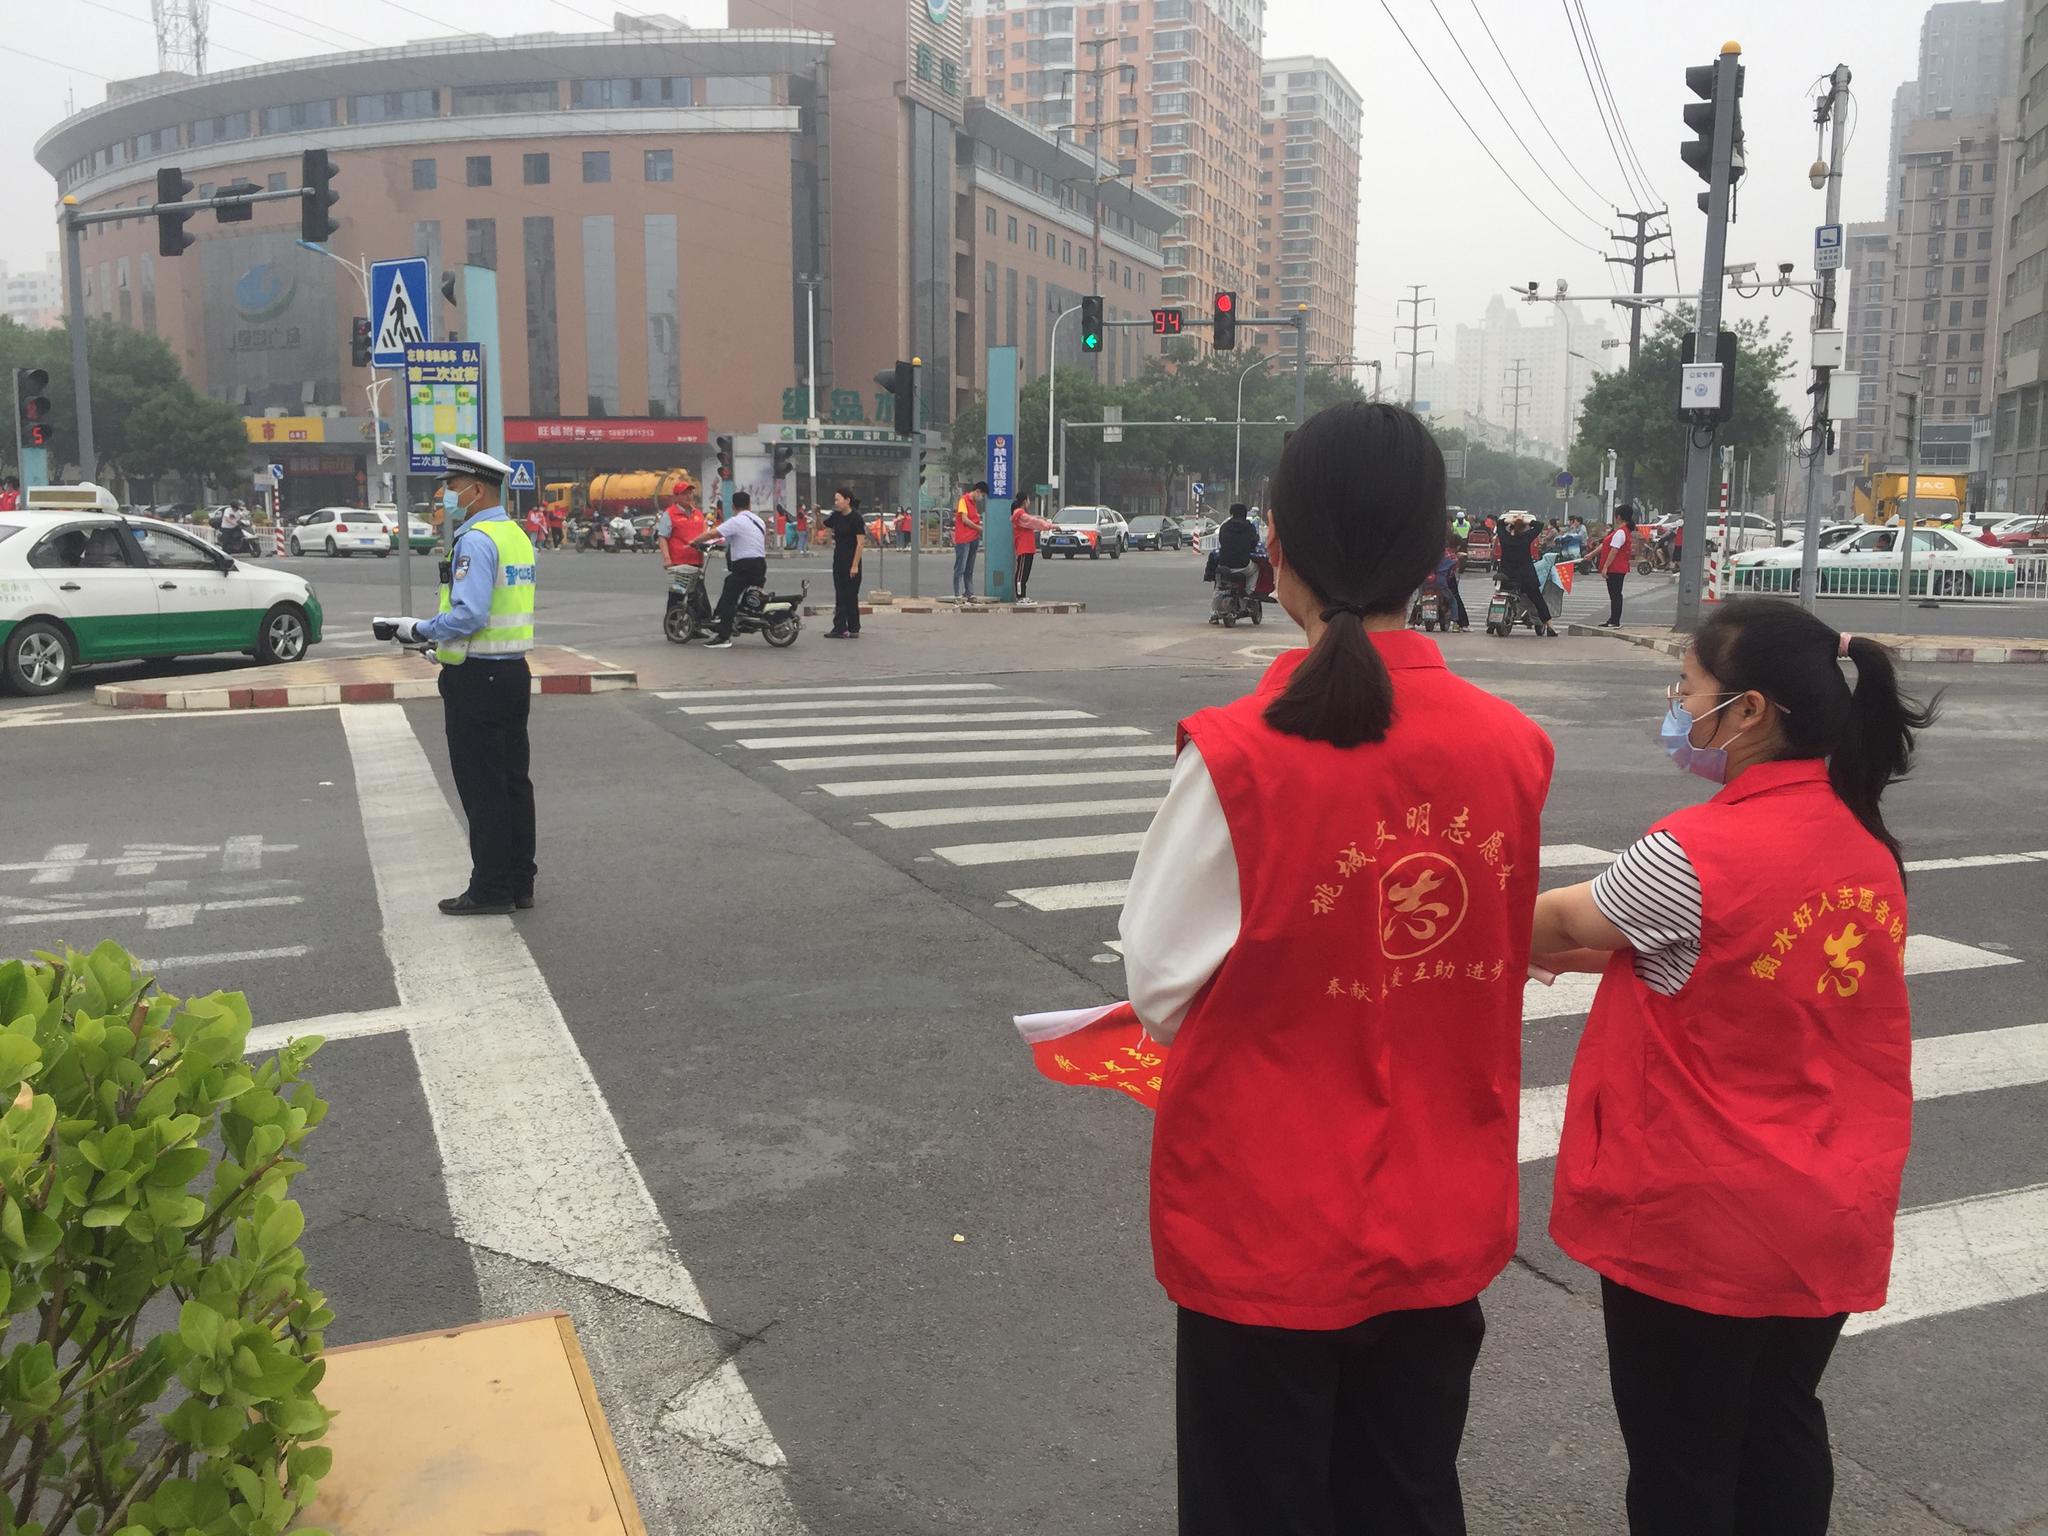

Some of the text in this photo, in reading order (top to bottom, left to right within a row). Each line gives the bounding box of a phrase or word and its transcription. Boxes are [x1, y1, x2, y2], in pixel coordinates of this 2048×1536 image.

[1153, 311, 1180, 333] 94
[32, 426, 45, 445] 5
[261, 420, 276, 441] 市
[1324, 976, 1374, 1003] 奉献
[1411, 959, 1456, 982] 互助
[1464, 958, 1506, 982] 进步
